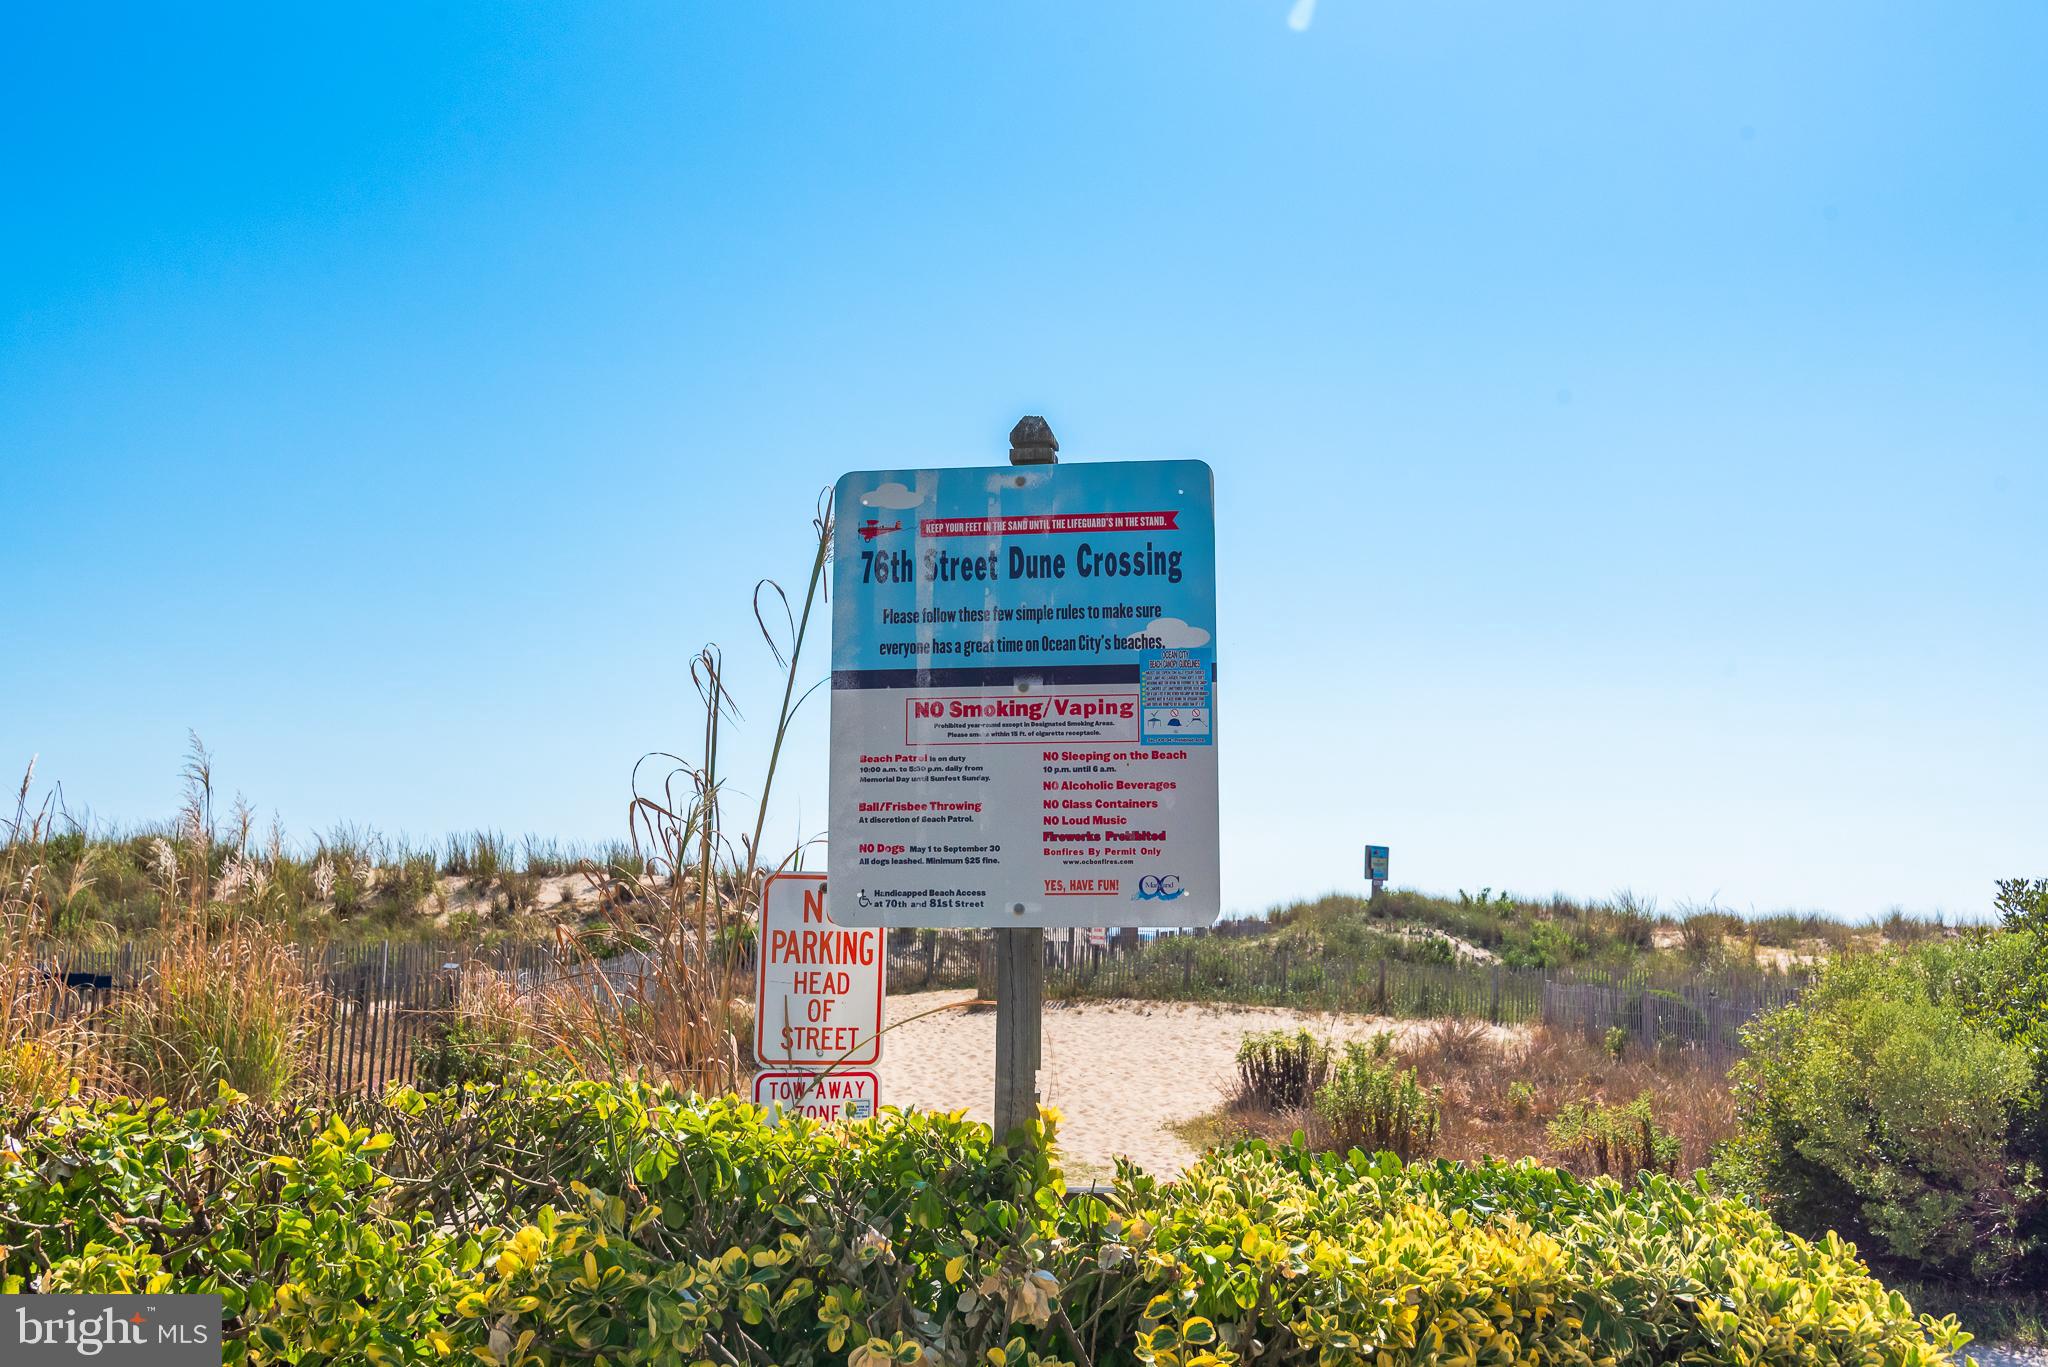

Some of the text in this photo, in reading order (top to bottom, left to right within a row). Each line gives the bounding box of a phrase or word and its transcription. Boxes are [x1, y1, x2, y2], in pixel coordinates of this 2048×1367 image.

[926, 515, 1167, 533] KEEP YOUR FEET IN THE SAND UNTIL THE LIFEGUARD'S IN THE STAND.
[861, 542, 1182, 583] 76th Street Dune Crossing
[883, 603, 1161, 624] Please follow these few simple rules to make sure
[880, 634, 1165, 658] everyone has a great time on Ocean City's beaches.
[915, 697, 1134, 720] NO Smoking/Vaping
[860, 755, 892, 763] Beach
[895, 754, 928, 762] Patrol
[1043, 750, 1187, 762] NO Sleeping on the Beach
[1043, 780, 1176, 791] NO Alcoholic Beverages
[859, 801, 982, 812] Ball/Frisbee Throwing
[1043, 799, 1158, 809] NO Glass Containers
[1044, 816, 1127, 825] NO Loud Music
[1043, 831, 1166, 842] Fireworks Prohibited
[859, 844, 874, 853] NO
[877, 844, 905, 854] Dogs
[943, 845, 987, 853] September
[1044, 848, 1084, 856] Bonfires
[1088, 848, 1100, 857] By
[1141, 847, 1161, 856] Only
[871, 858, 889, 866] dogs
[1044, 880, 1119, 892] YES, HAVE FUN!
[874, 890, 927, 898] Handicapped
[930, 899, 952, 907] 81st
[771, 930, 874, 966] PARKING
[794, 972, 850, 995] HEAD
[808, 999, 835, 1022] OF
[780, 1027, 859, 1050] STREET
[770, 1081, 865, 1100] TOW-AWAY
